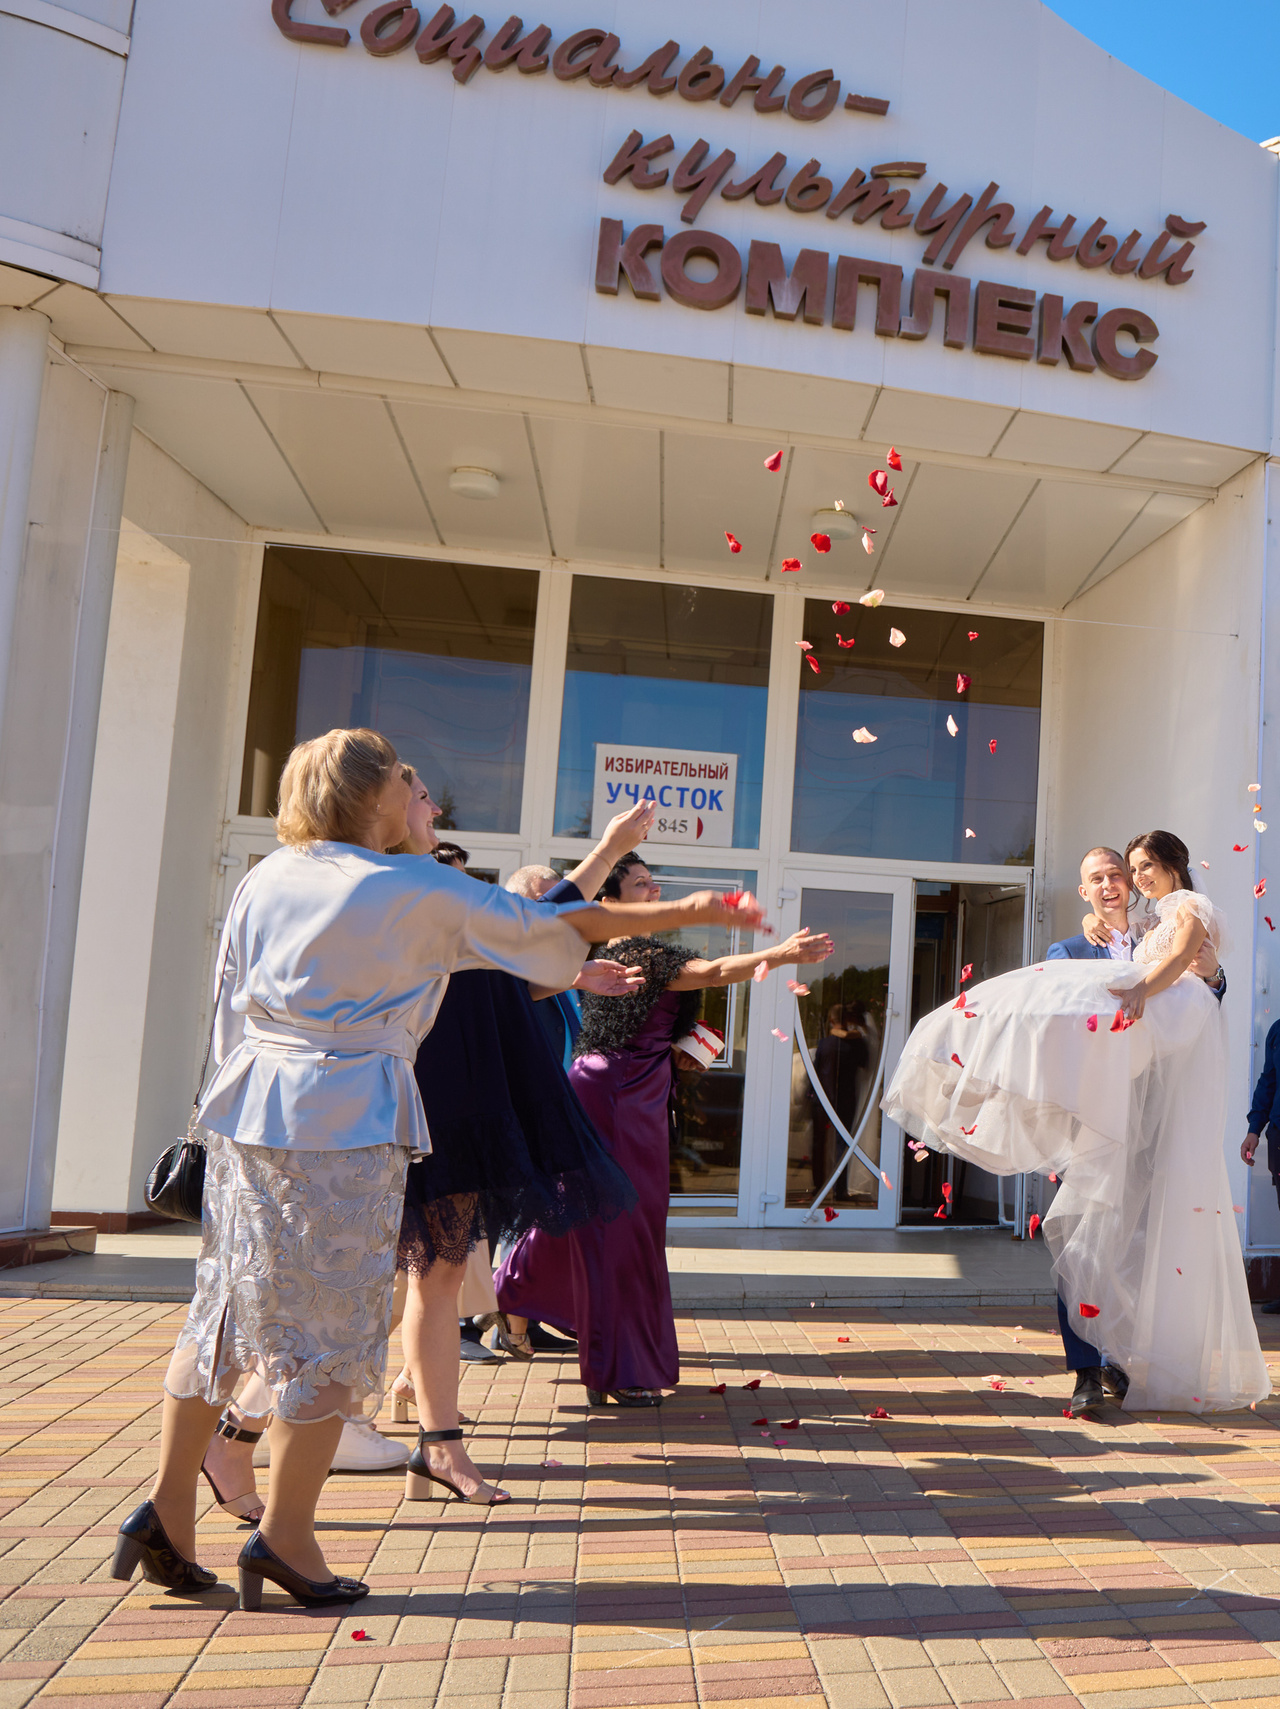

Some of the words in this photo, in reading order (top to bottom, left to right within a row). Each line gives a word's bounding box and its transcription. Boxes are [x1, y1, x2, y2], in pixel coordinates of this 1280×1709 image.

[604, 130, 1207, 285] культурный
[595, 217, 1159, 381] КОМПЛЕКС
[605, 756, 728, 780] ИЗБИРАТЕЛЬНЫЙ
[606, 782, 723, 811] УЧАСТОК
[657, 818, 688, 833] 845
